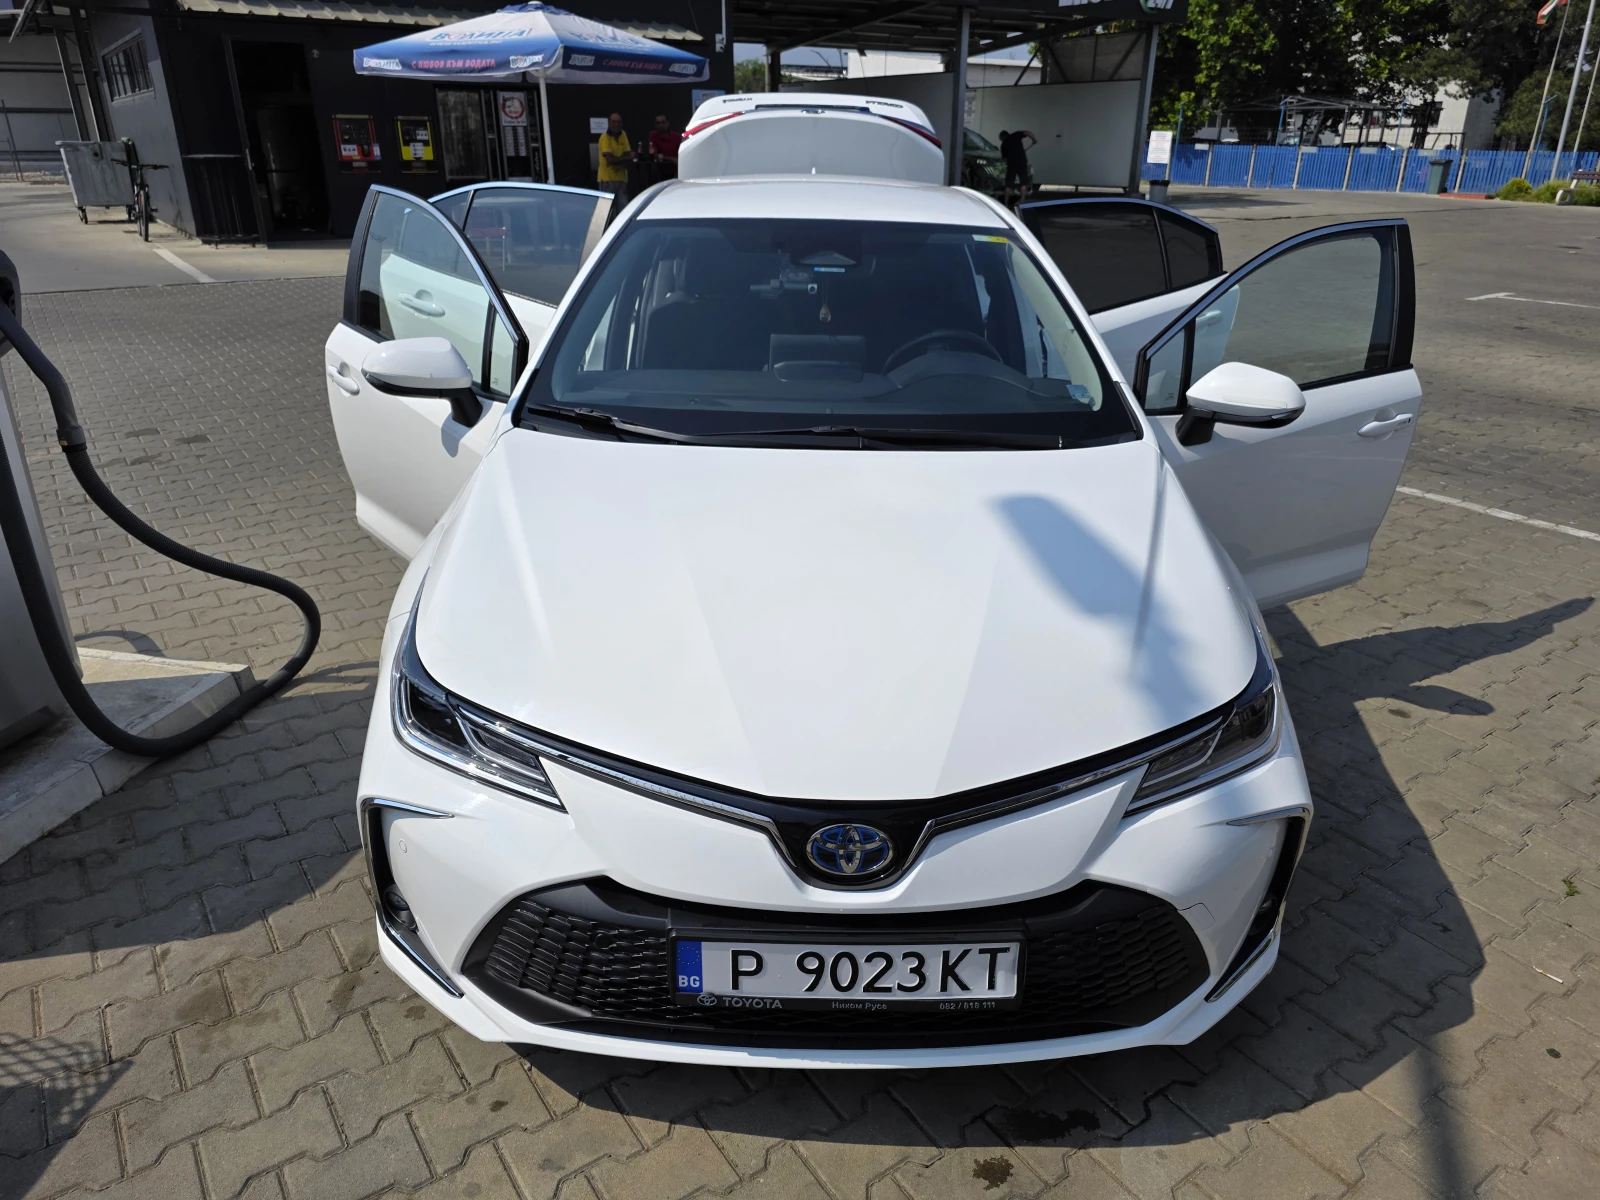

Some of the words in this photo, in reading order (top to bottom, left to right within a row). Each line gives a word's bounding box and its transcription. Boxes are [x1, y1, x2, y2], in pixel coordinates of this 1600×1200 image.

[418, 60, 445, 69] ЛЮБОВ
[446, 59, 464, 68] КЪМ
[465, 58, 496, 69] ВОДАТА
[730, 949, 764, 991] P
[678, 975, 700, 988] BG
[723, 997, 783, 1009] TOYOTA
[832, 1001, 863, 1010] Ником
[865, 1002, 888, 1011] Русе
[982, 1001, 996, 1009] 111
